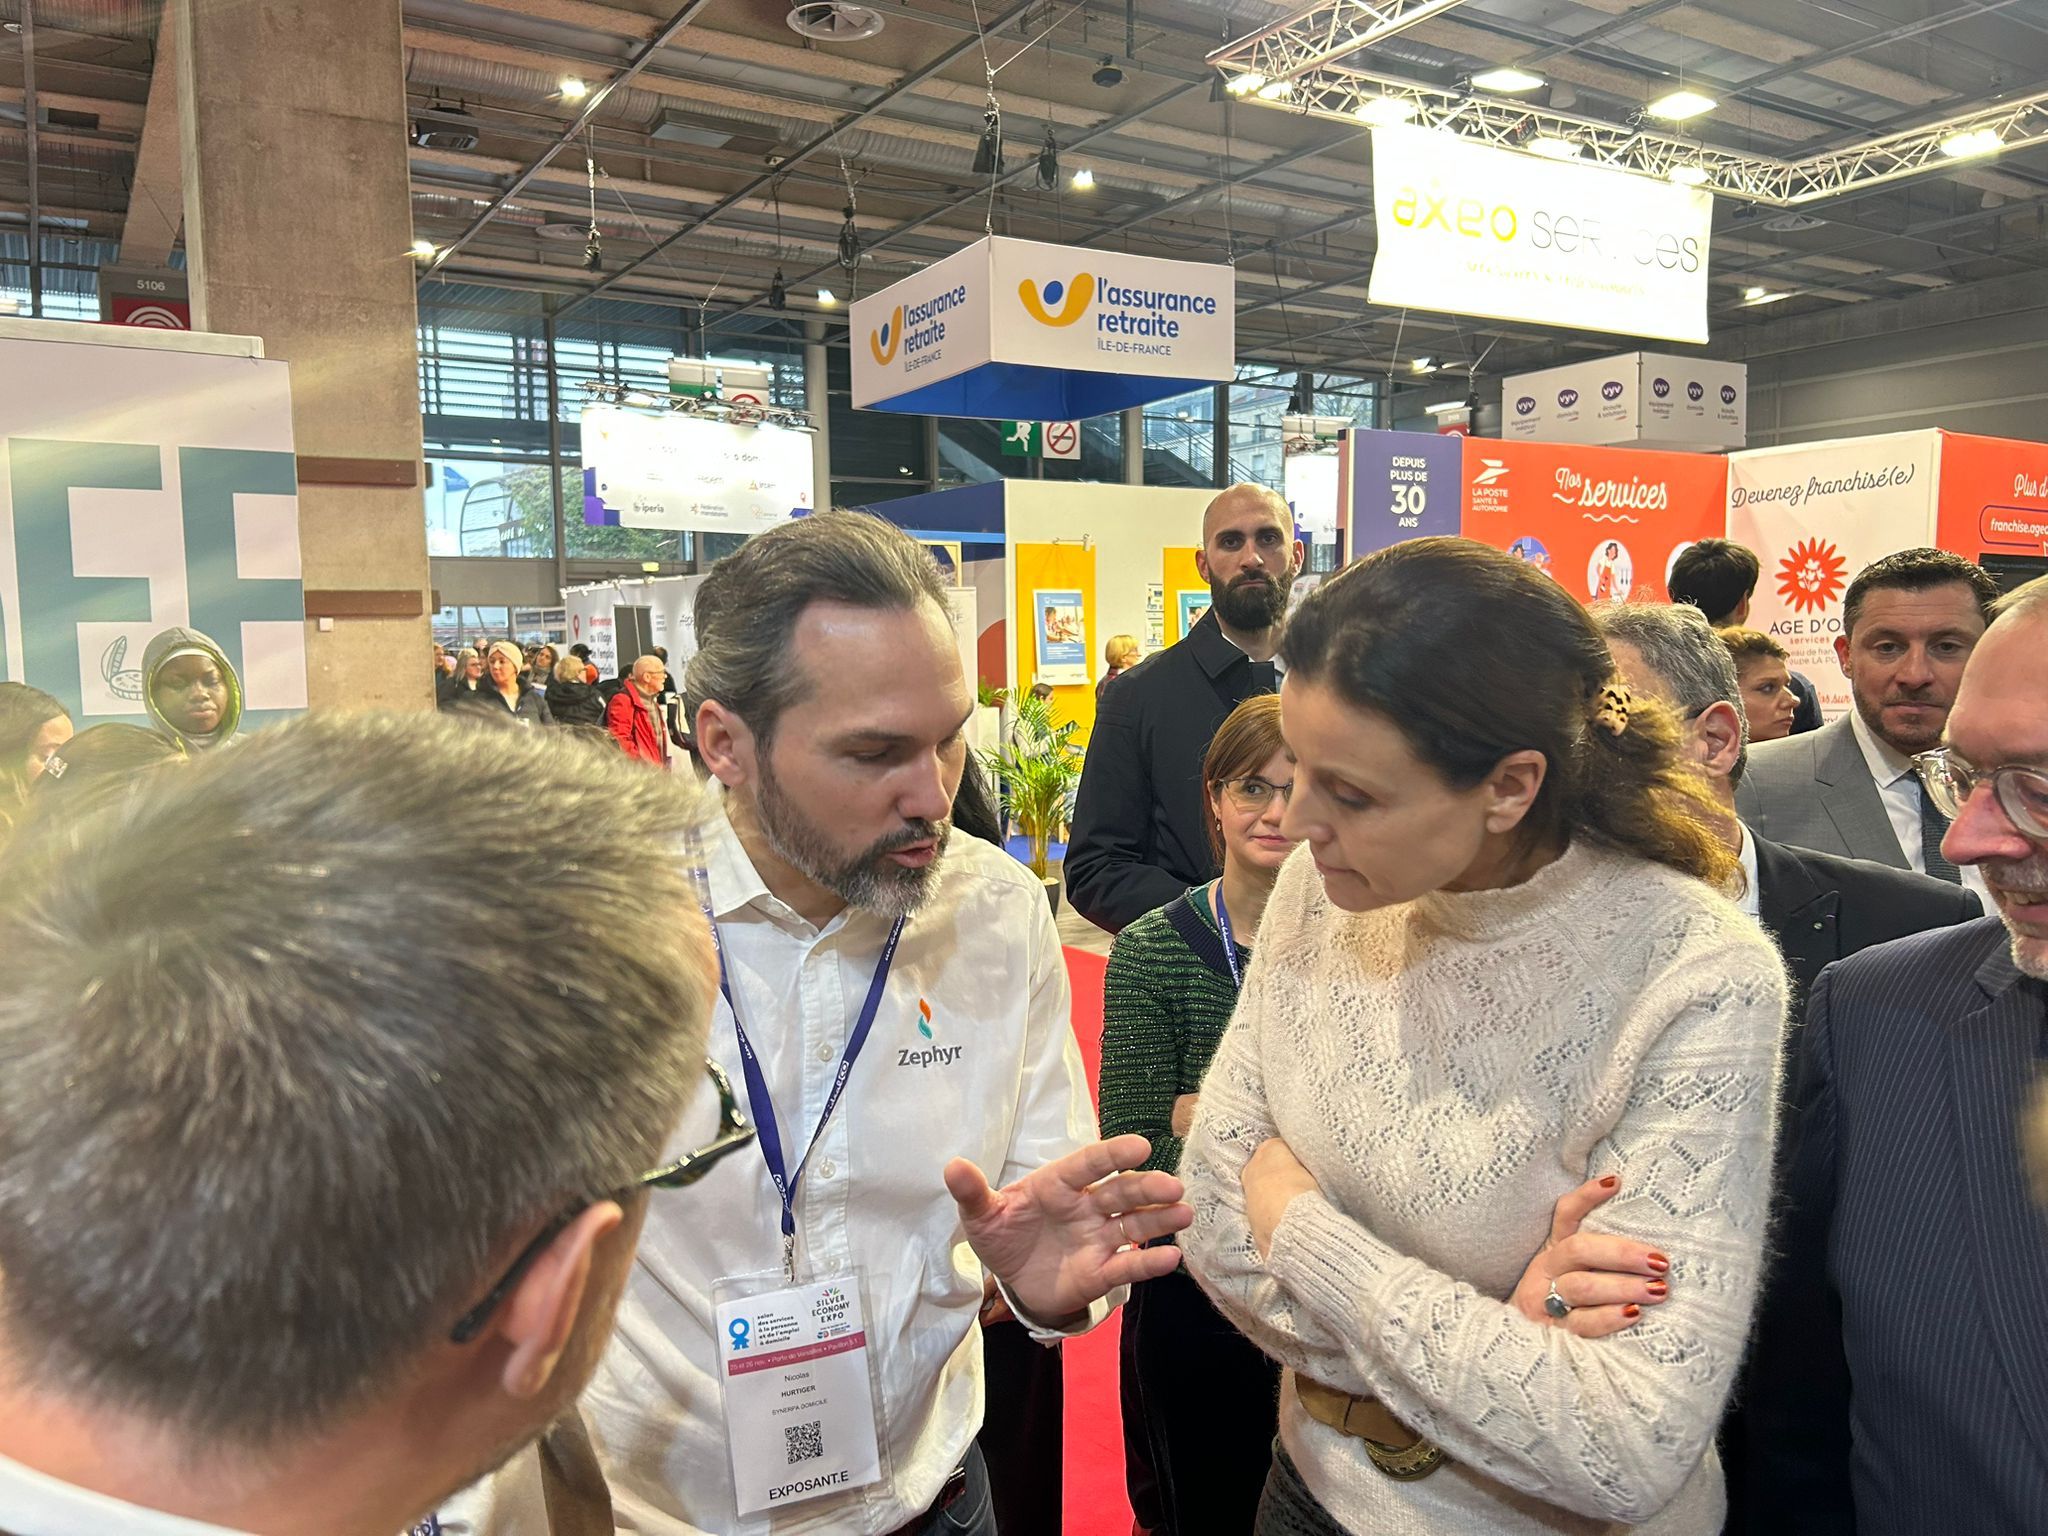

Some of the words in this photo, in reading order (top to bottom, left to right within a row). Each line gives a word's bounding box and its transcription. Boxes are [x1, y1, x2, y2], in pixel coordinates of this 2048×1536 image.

[137, 279, 166, 291] 5106
[1097, 277, 1217, 315] l'assurance
[1097, 310, 1179, 338] retraite
[904, 319, 945, 355] retraite
[1096, 337, 1172, 356] ÎLE-DE-FRANCE
[1392, 456, 1426, 469] DEPUIS
[1390, 470, 1413, 481] PLUS
[1414, 471, 1428, 482] DE
[1555, 467, 1582, 491] Nos
[1577, 475, 1667, 510] services
[1731, 486, 1804, 509] Devenez
[1804, 463, 1915, 505] franchisé(e)
[2013, 473, 2038, 498] Plus
[1390, 484, 1426, 515] 30
[1472, 488, 1483, 497] LA
[1483, 488, 1509, 498] POSTE
[1398, 517, 1419, 528] ANS
[1769, 619, 1804, 635] AGE
[1790, 636, 1830, 645] services
[1812, 656, 1823, 664] LA
[898, 1045, 962, 1068] Zephyr
[816, 1294, 845, 1307] SILVER
[811, 1302, 850, 1317] ECONOMY
[770, 1316, 794, 1324] services
[821, 1312, 844, 1323] EXPO
[784, 1371, 810, 1382] Nicolas
[781, 1385, 816, 1398] HURTIGER
[801, 1398, 828, 1410] DOMICILE
[769, 1470, 849, 1500] EXPOSANT.E
